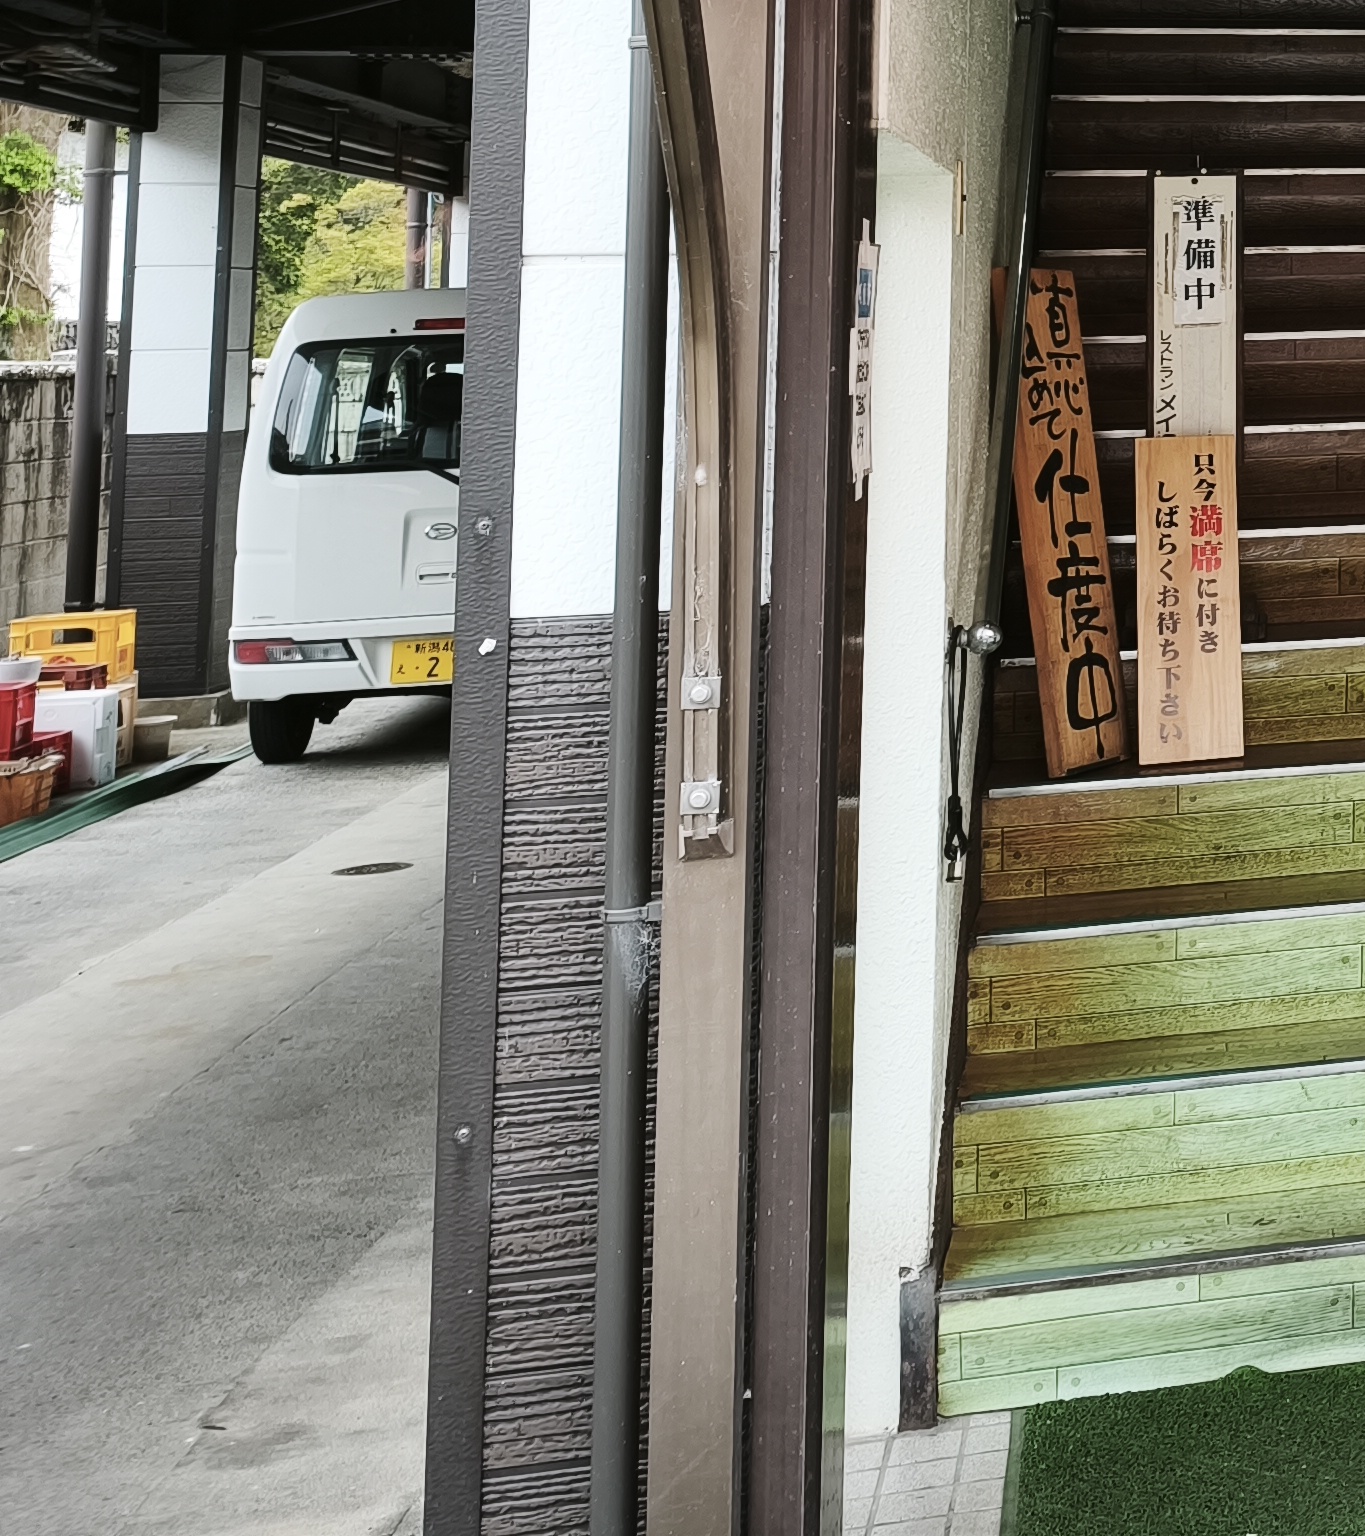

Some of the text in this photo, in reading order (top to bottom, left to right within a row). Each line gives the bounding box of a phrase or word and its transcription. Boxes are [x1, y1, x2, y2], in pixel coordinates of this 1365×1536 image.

[1181, 196, 1216, 310] 準備中
[1156, 330, 1176, 437] レストラン メイ
[1155, 480, 1183, 743] しばらくお待ち下さい
[1190, 453, 1223, 653] 只今満席に付き
